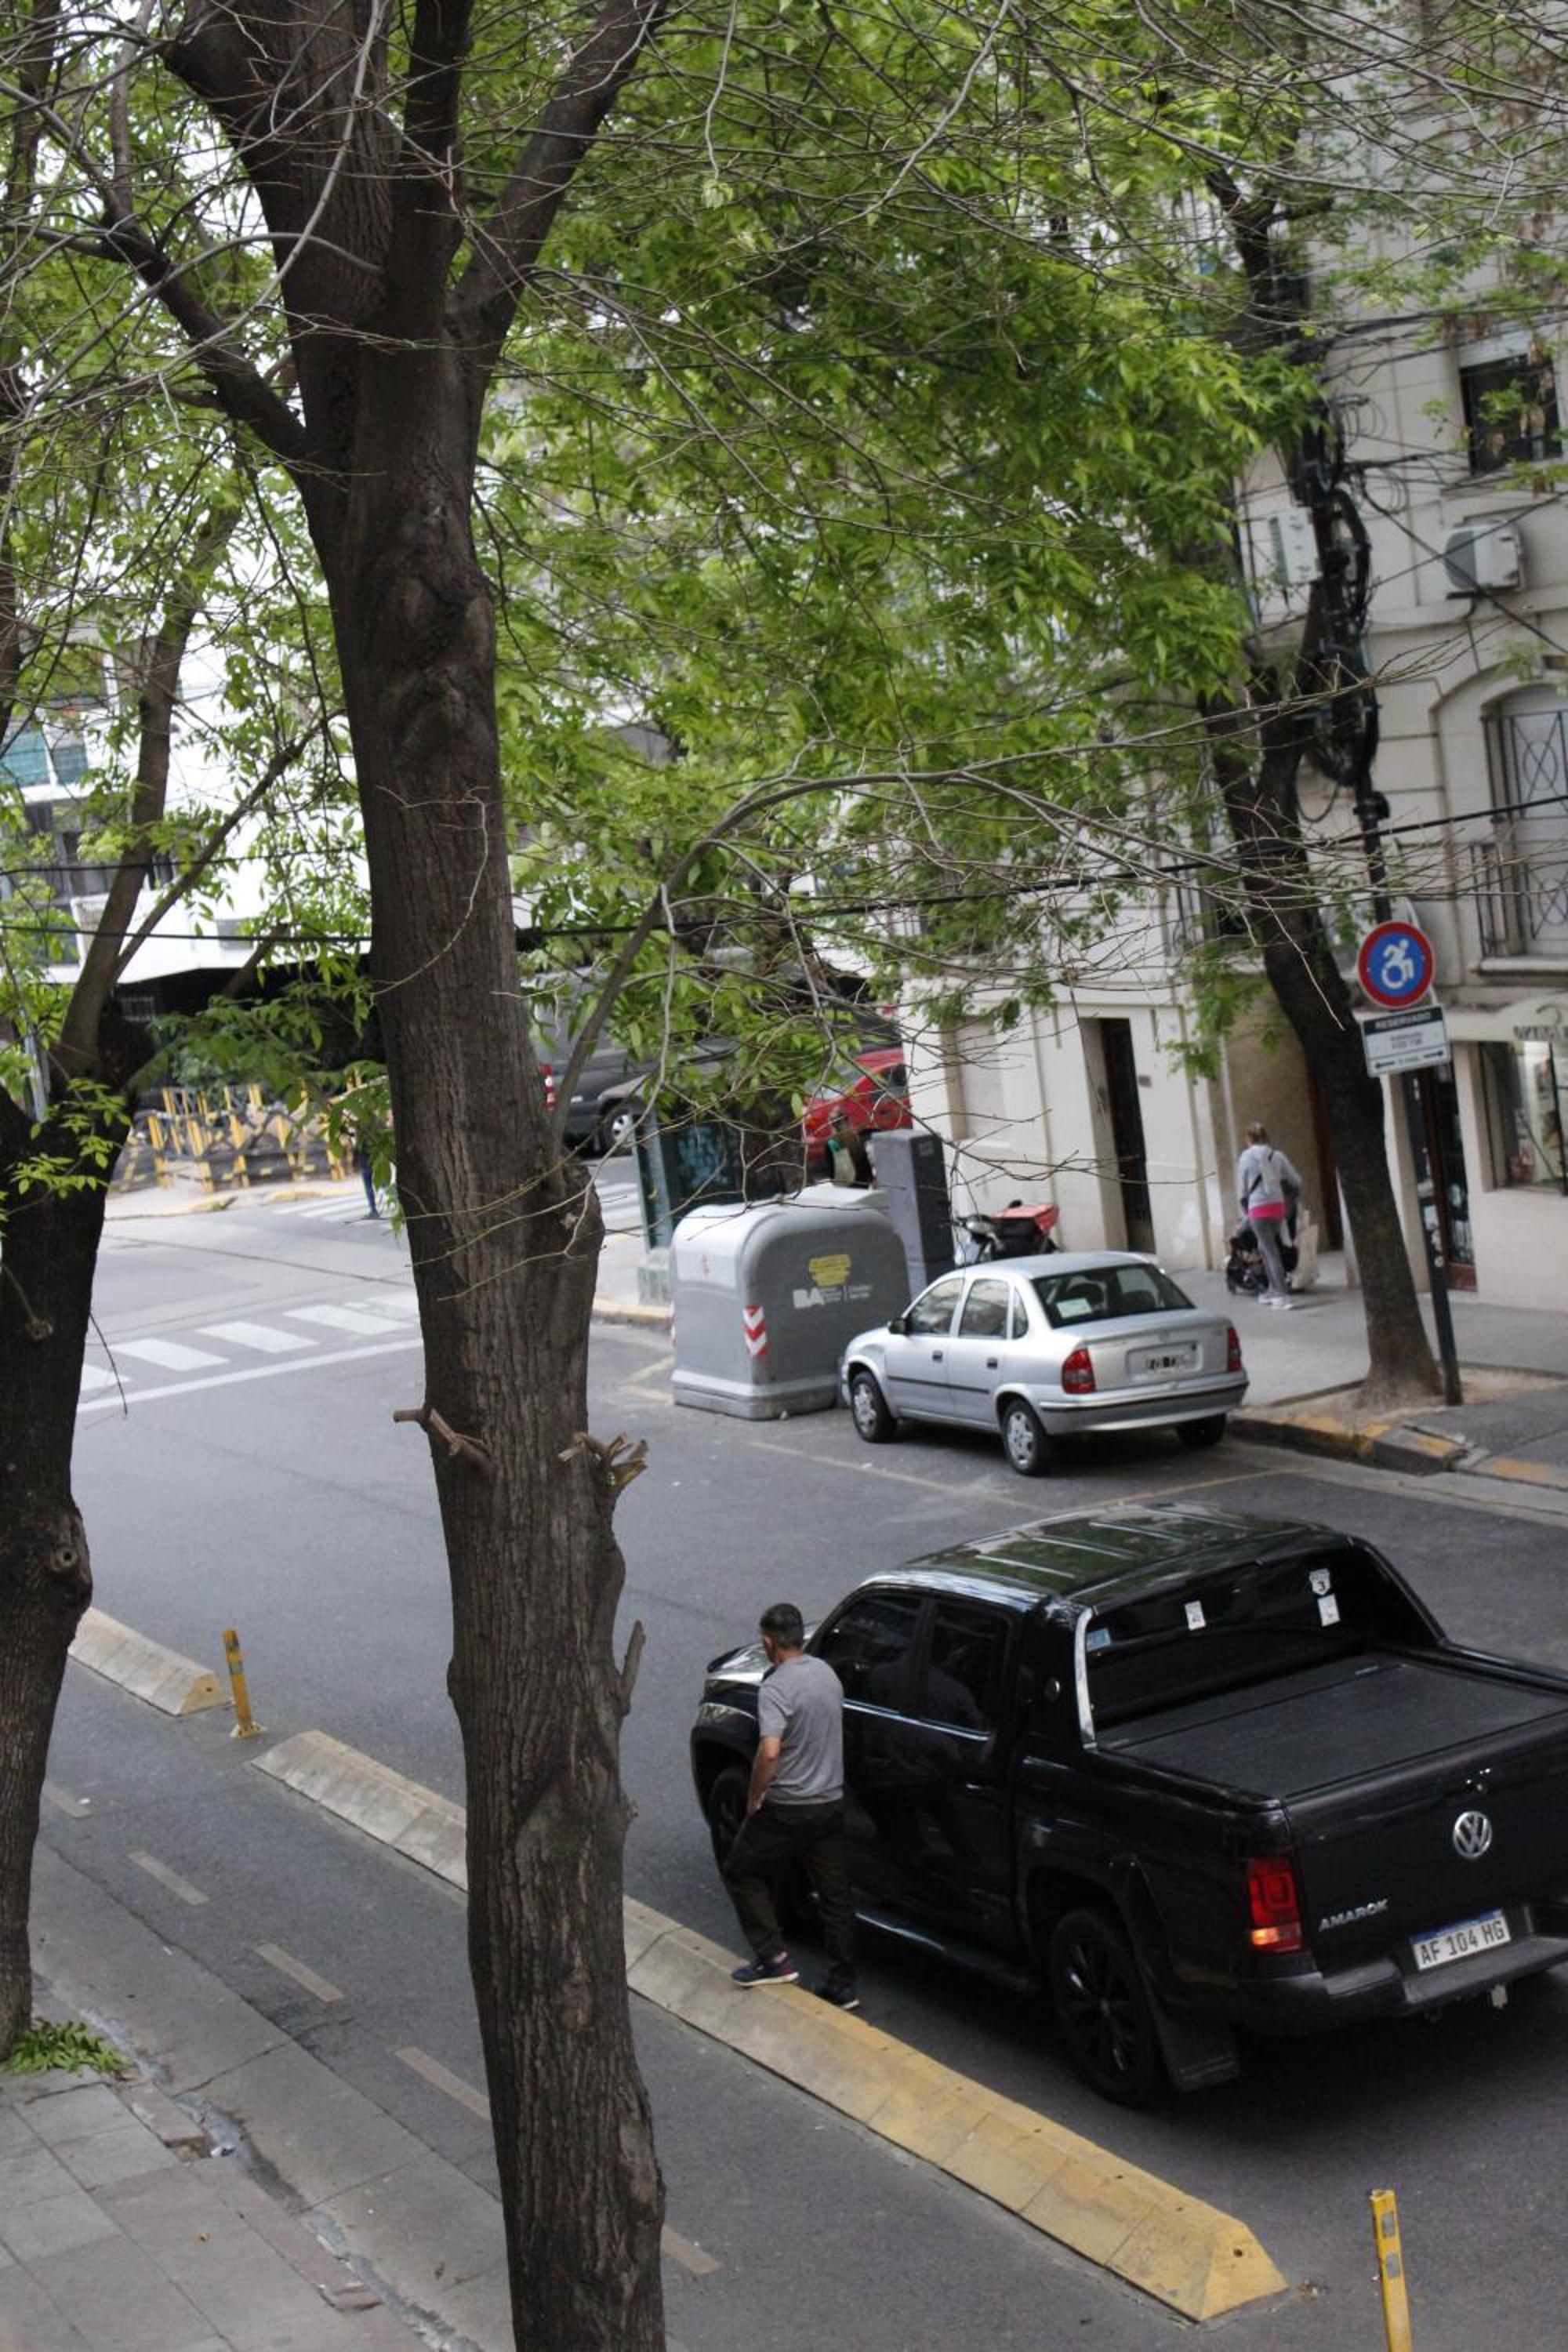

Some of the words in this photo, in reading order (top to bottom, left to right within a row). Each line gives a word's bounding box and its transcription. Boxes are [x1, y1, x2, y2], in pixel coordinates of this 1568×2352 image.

[1375, 1011, 1432, 1029] RESERVADO
[1318, 1898, 1388, 1932] AMAROK
[1421, 1940, 1440, 1965] AF
[1446, 1928, 1478, 1956] 104
[1481, 1919, 1505, 1944] HG
